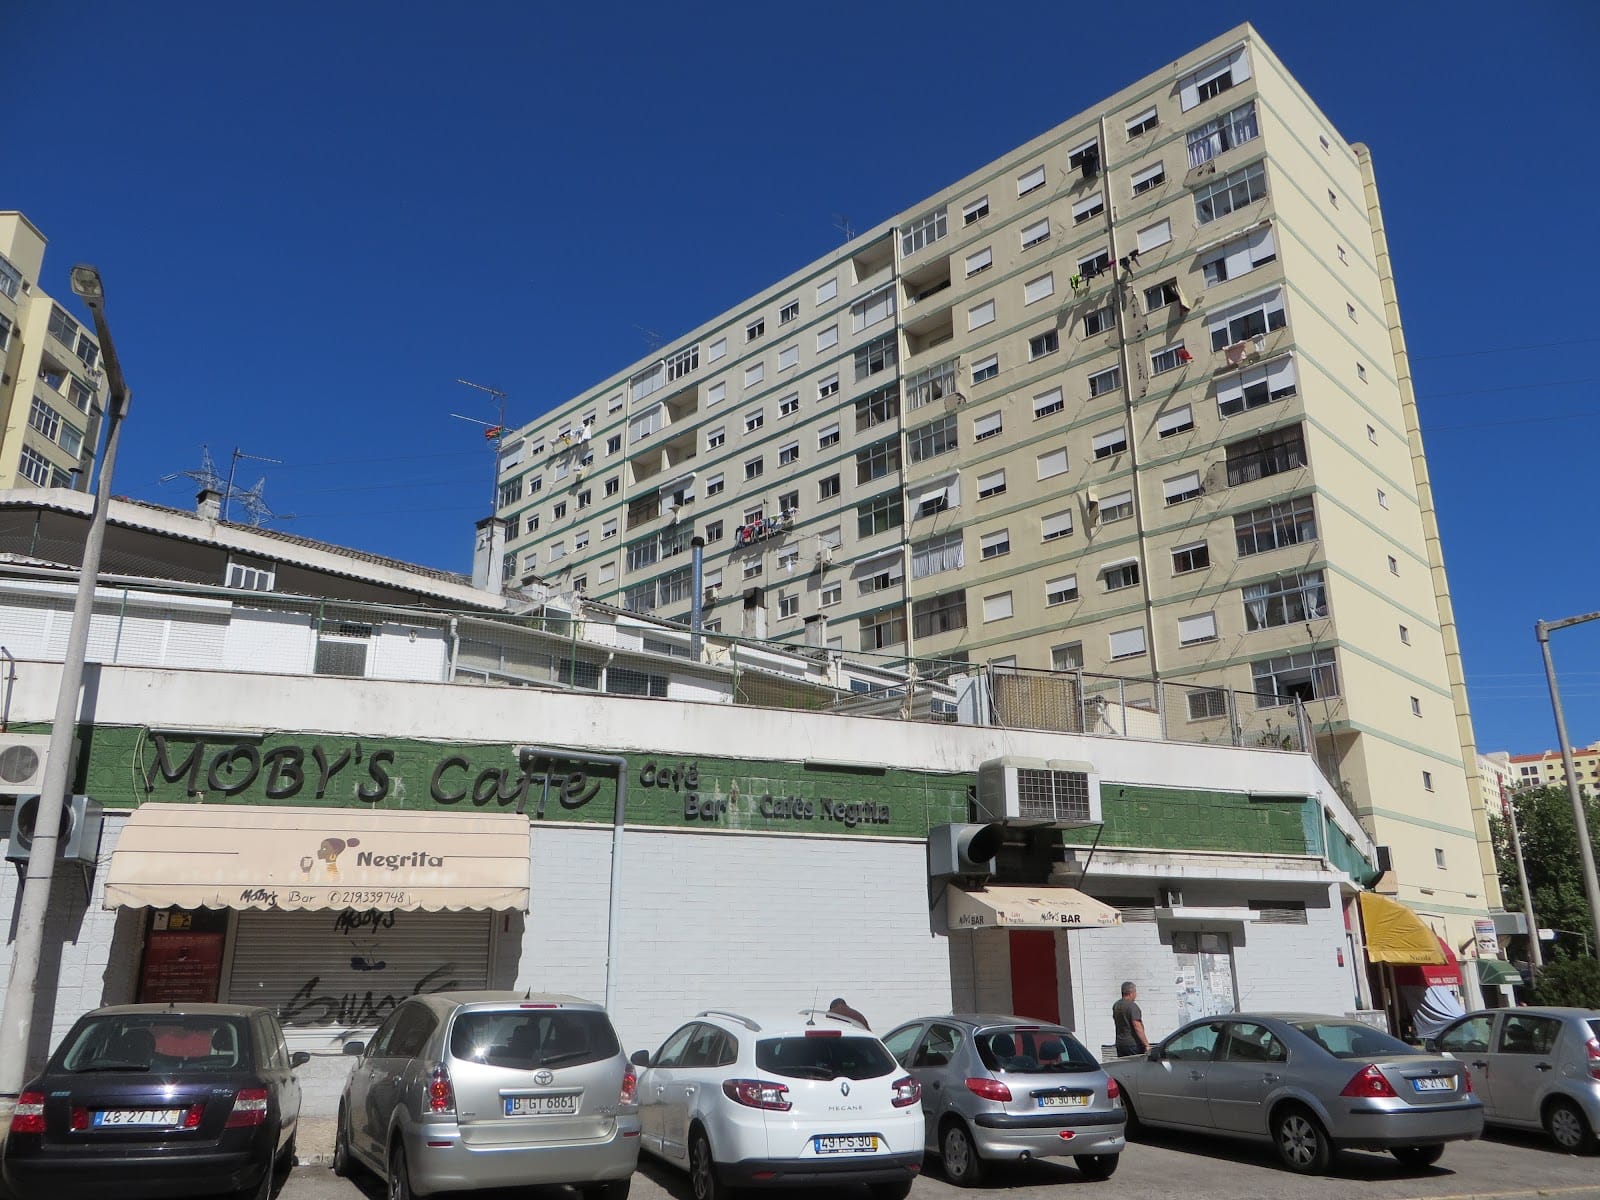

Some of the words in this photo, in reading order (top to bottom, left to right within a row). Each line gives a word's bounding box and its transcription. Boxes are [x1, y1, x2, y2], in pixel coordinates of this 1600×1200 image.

[145, 735, 395, 801] MOBY'S
[640, 760, 698, 793] Café
[685, 792, 727, 821] Bar
[820, 798, 889, 828] Negrita
[357, 851, 443, 871] Negrita
[288, 891, 316, 902] Bar
[342, 891, 405, 904] 219339748
[1061, 915, 1080, 923] BAR
[546, 1096, 575, 1109] 6861
